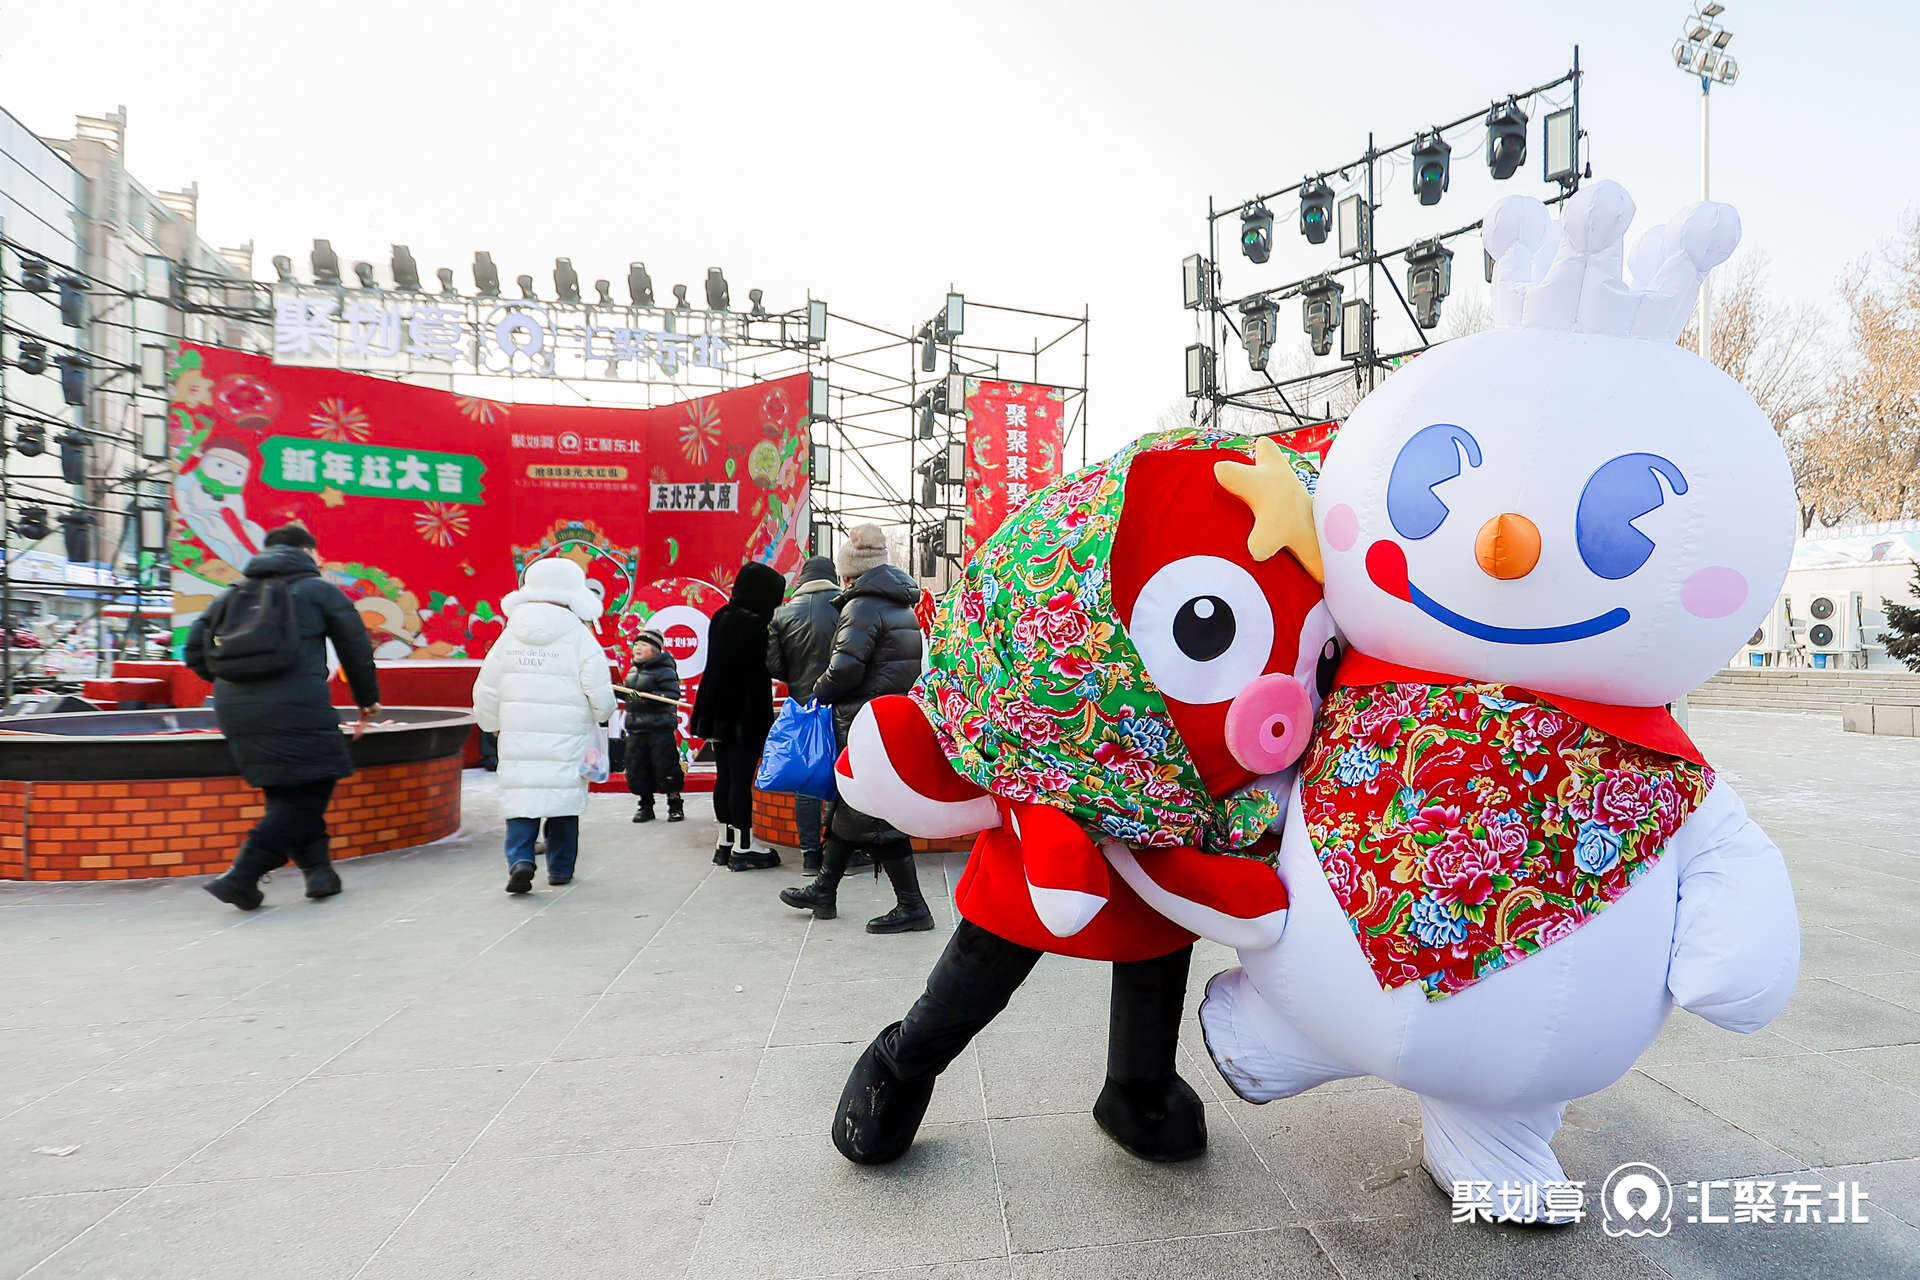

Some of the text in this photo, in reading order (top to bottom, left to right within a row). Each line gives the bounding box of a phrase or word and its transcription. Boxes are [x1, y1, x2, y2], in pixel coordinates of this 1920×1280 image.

[273, 296, 464, 362] 聚划算
[281, 447, 464, 494] 新年赶大吉
[656, 478, 731, 510] 东北开大席
